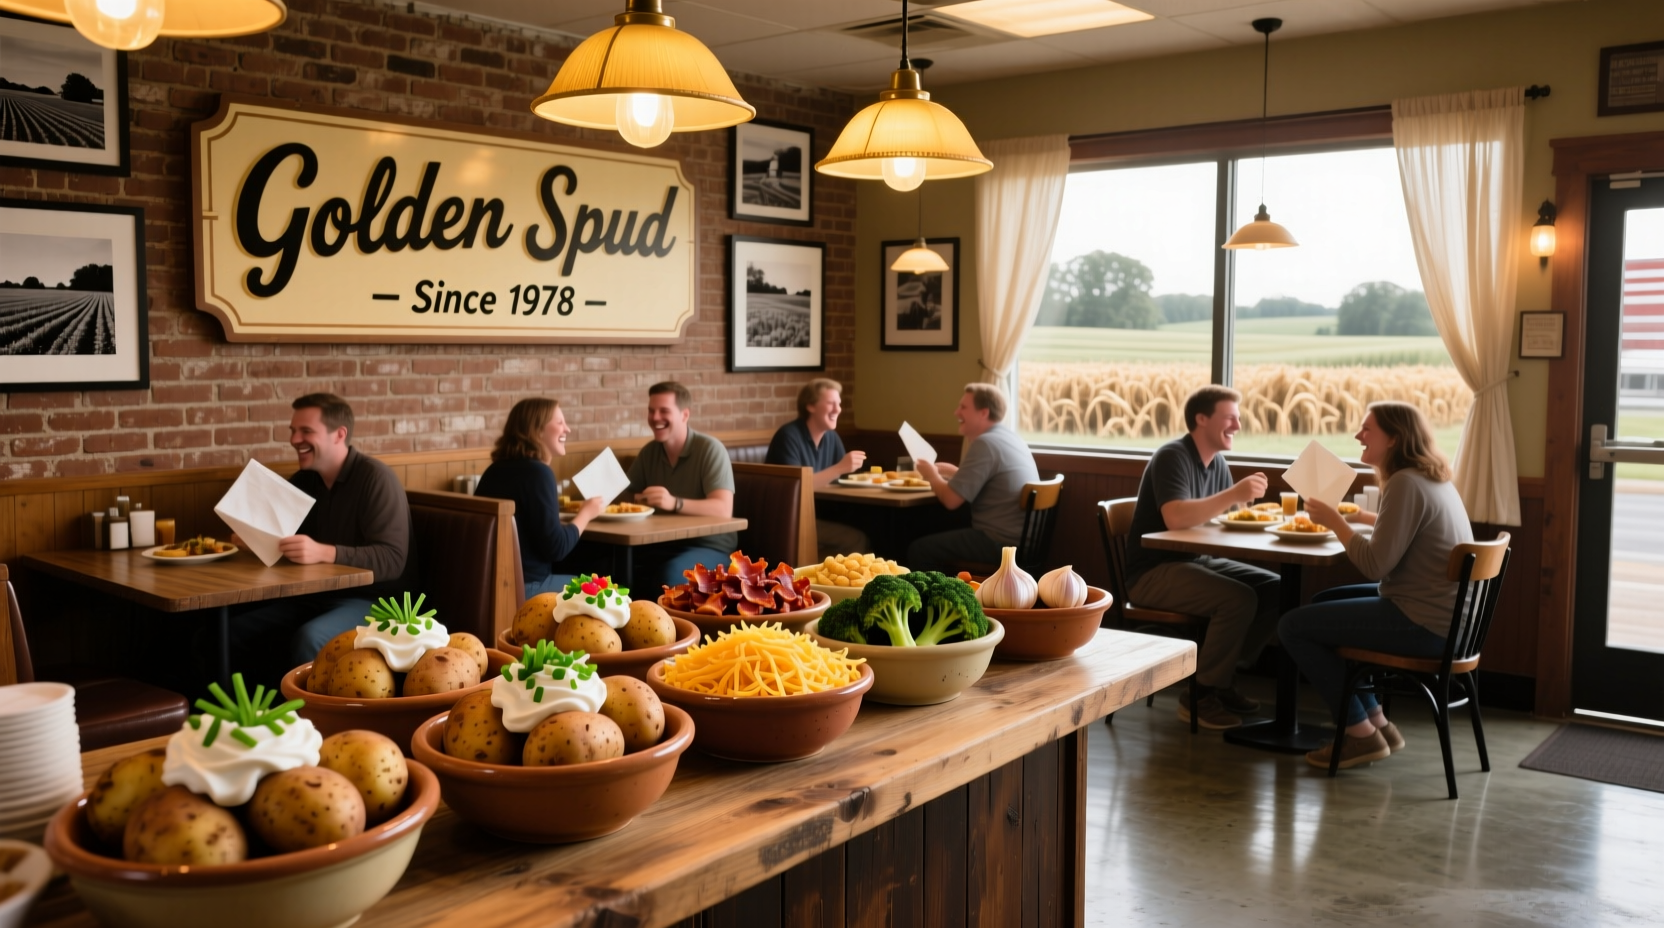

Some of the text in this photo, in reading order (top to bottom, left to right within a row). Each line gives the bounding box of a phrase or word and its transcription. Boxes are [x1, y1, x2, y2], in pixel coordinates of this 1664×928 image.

[235, 142, 679, 298] Golden Spud
[411, 280, 575, 316] Since 1978
